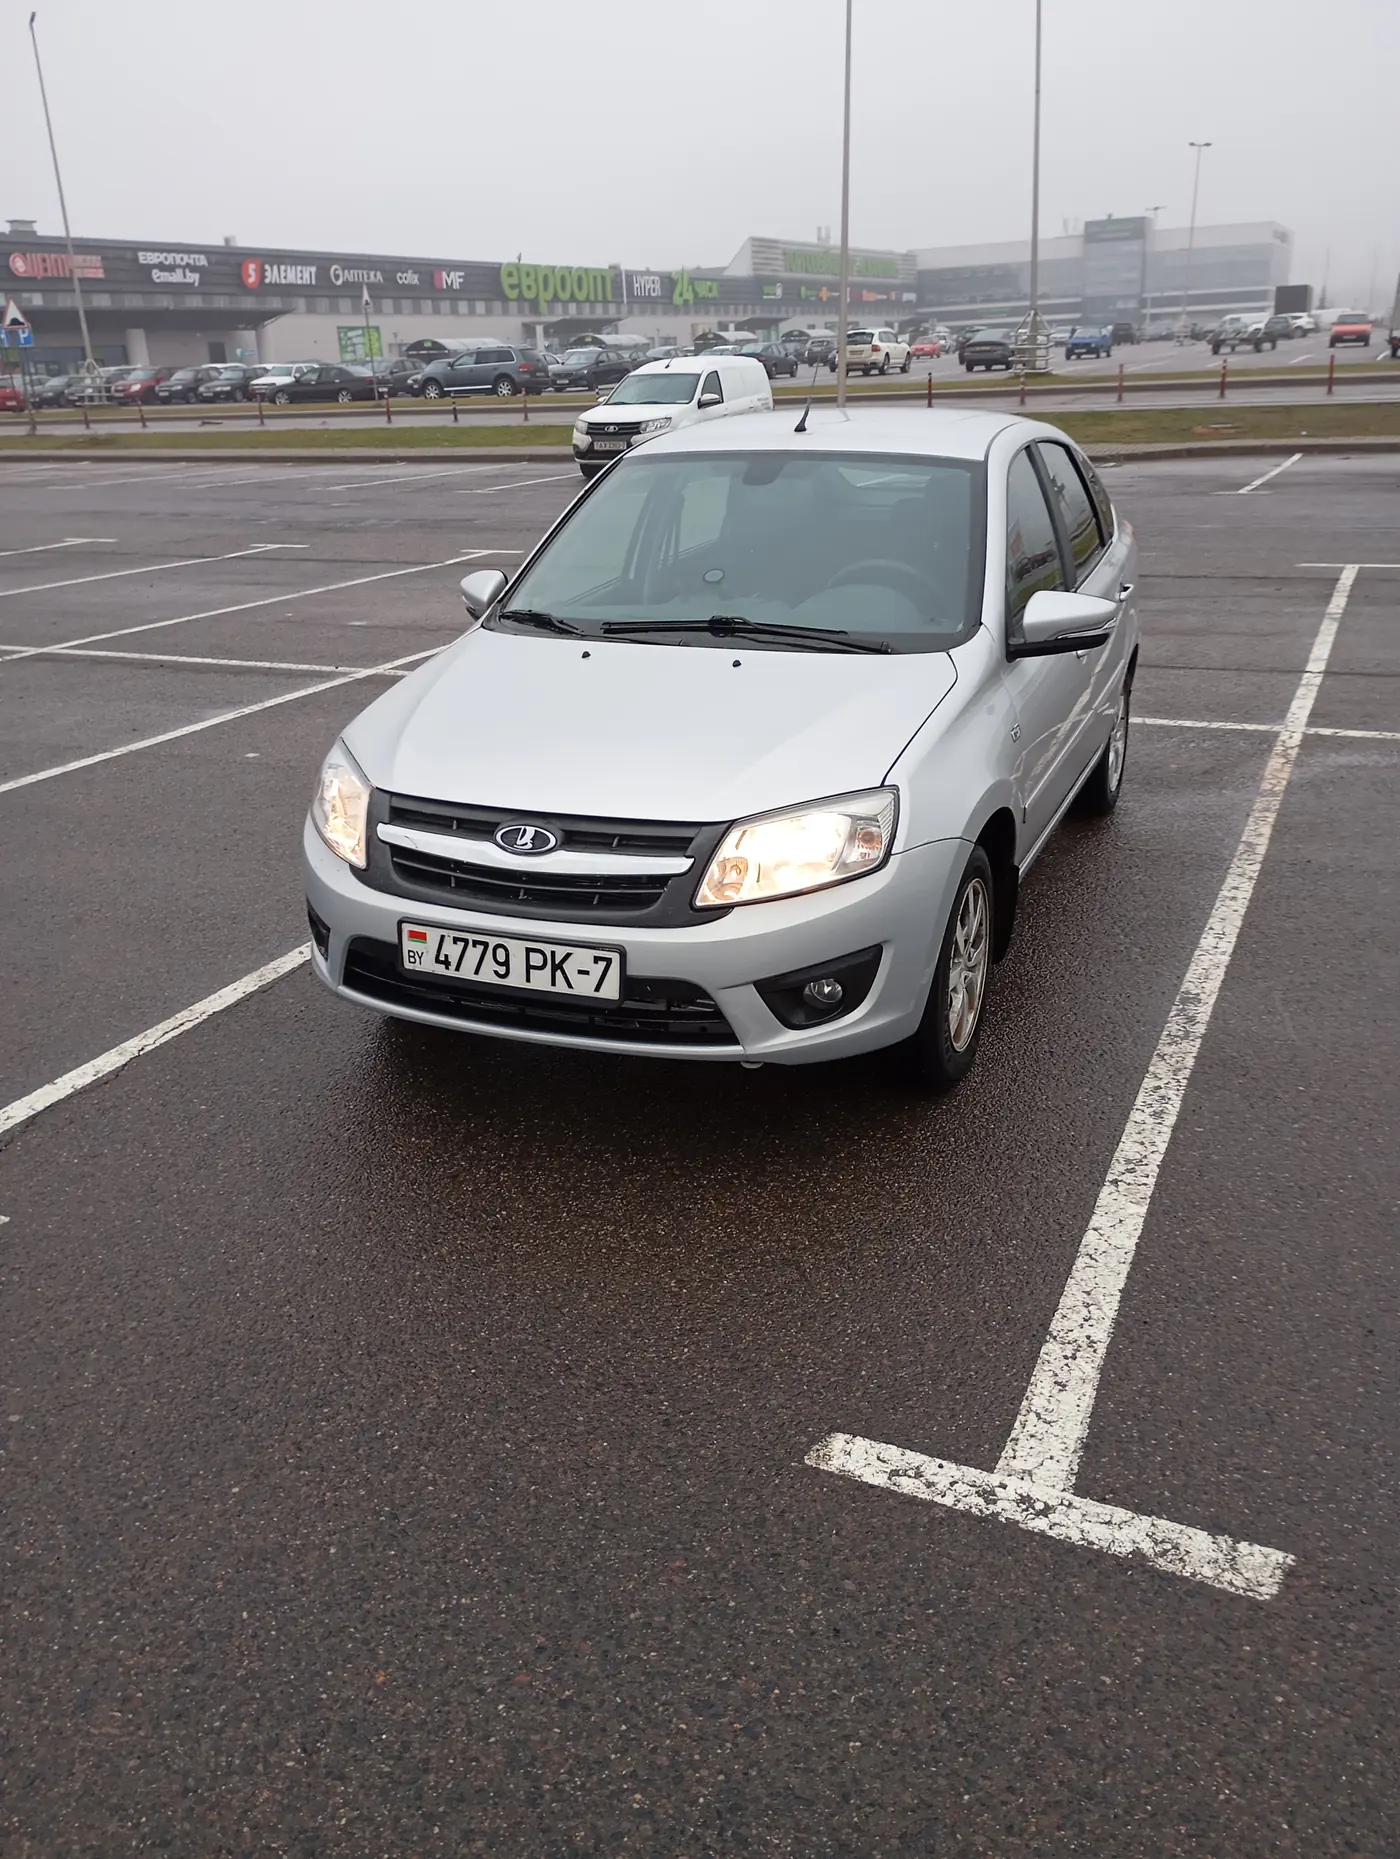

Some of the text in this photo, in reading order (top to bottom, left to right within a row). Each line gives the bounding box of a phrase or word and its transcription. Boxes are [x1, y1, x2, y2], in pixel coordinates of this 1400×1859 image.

[137, 251, 208, 267] ЕВРОПОЧТА
[248, 263, 317, 285] 5 ЭЛЕМЕНТ
[343, 269, 384, 284] АПТЕКА
[442, 271, 465, 289] MF
[500, 262, 614, 315] евроопт
[633, 275, 661, 297] HYPER
[407, 934, 613, 993] BY 4779 PK-7
